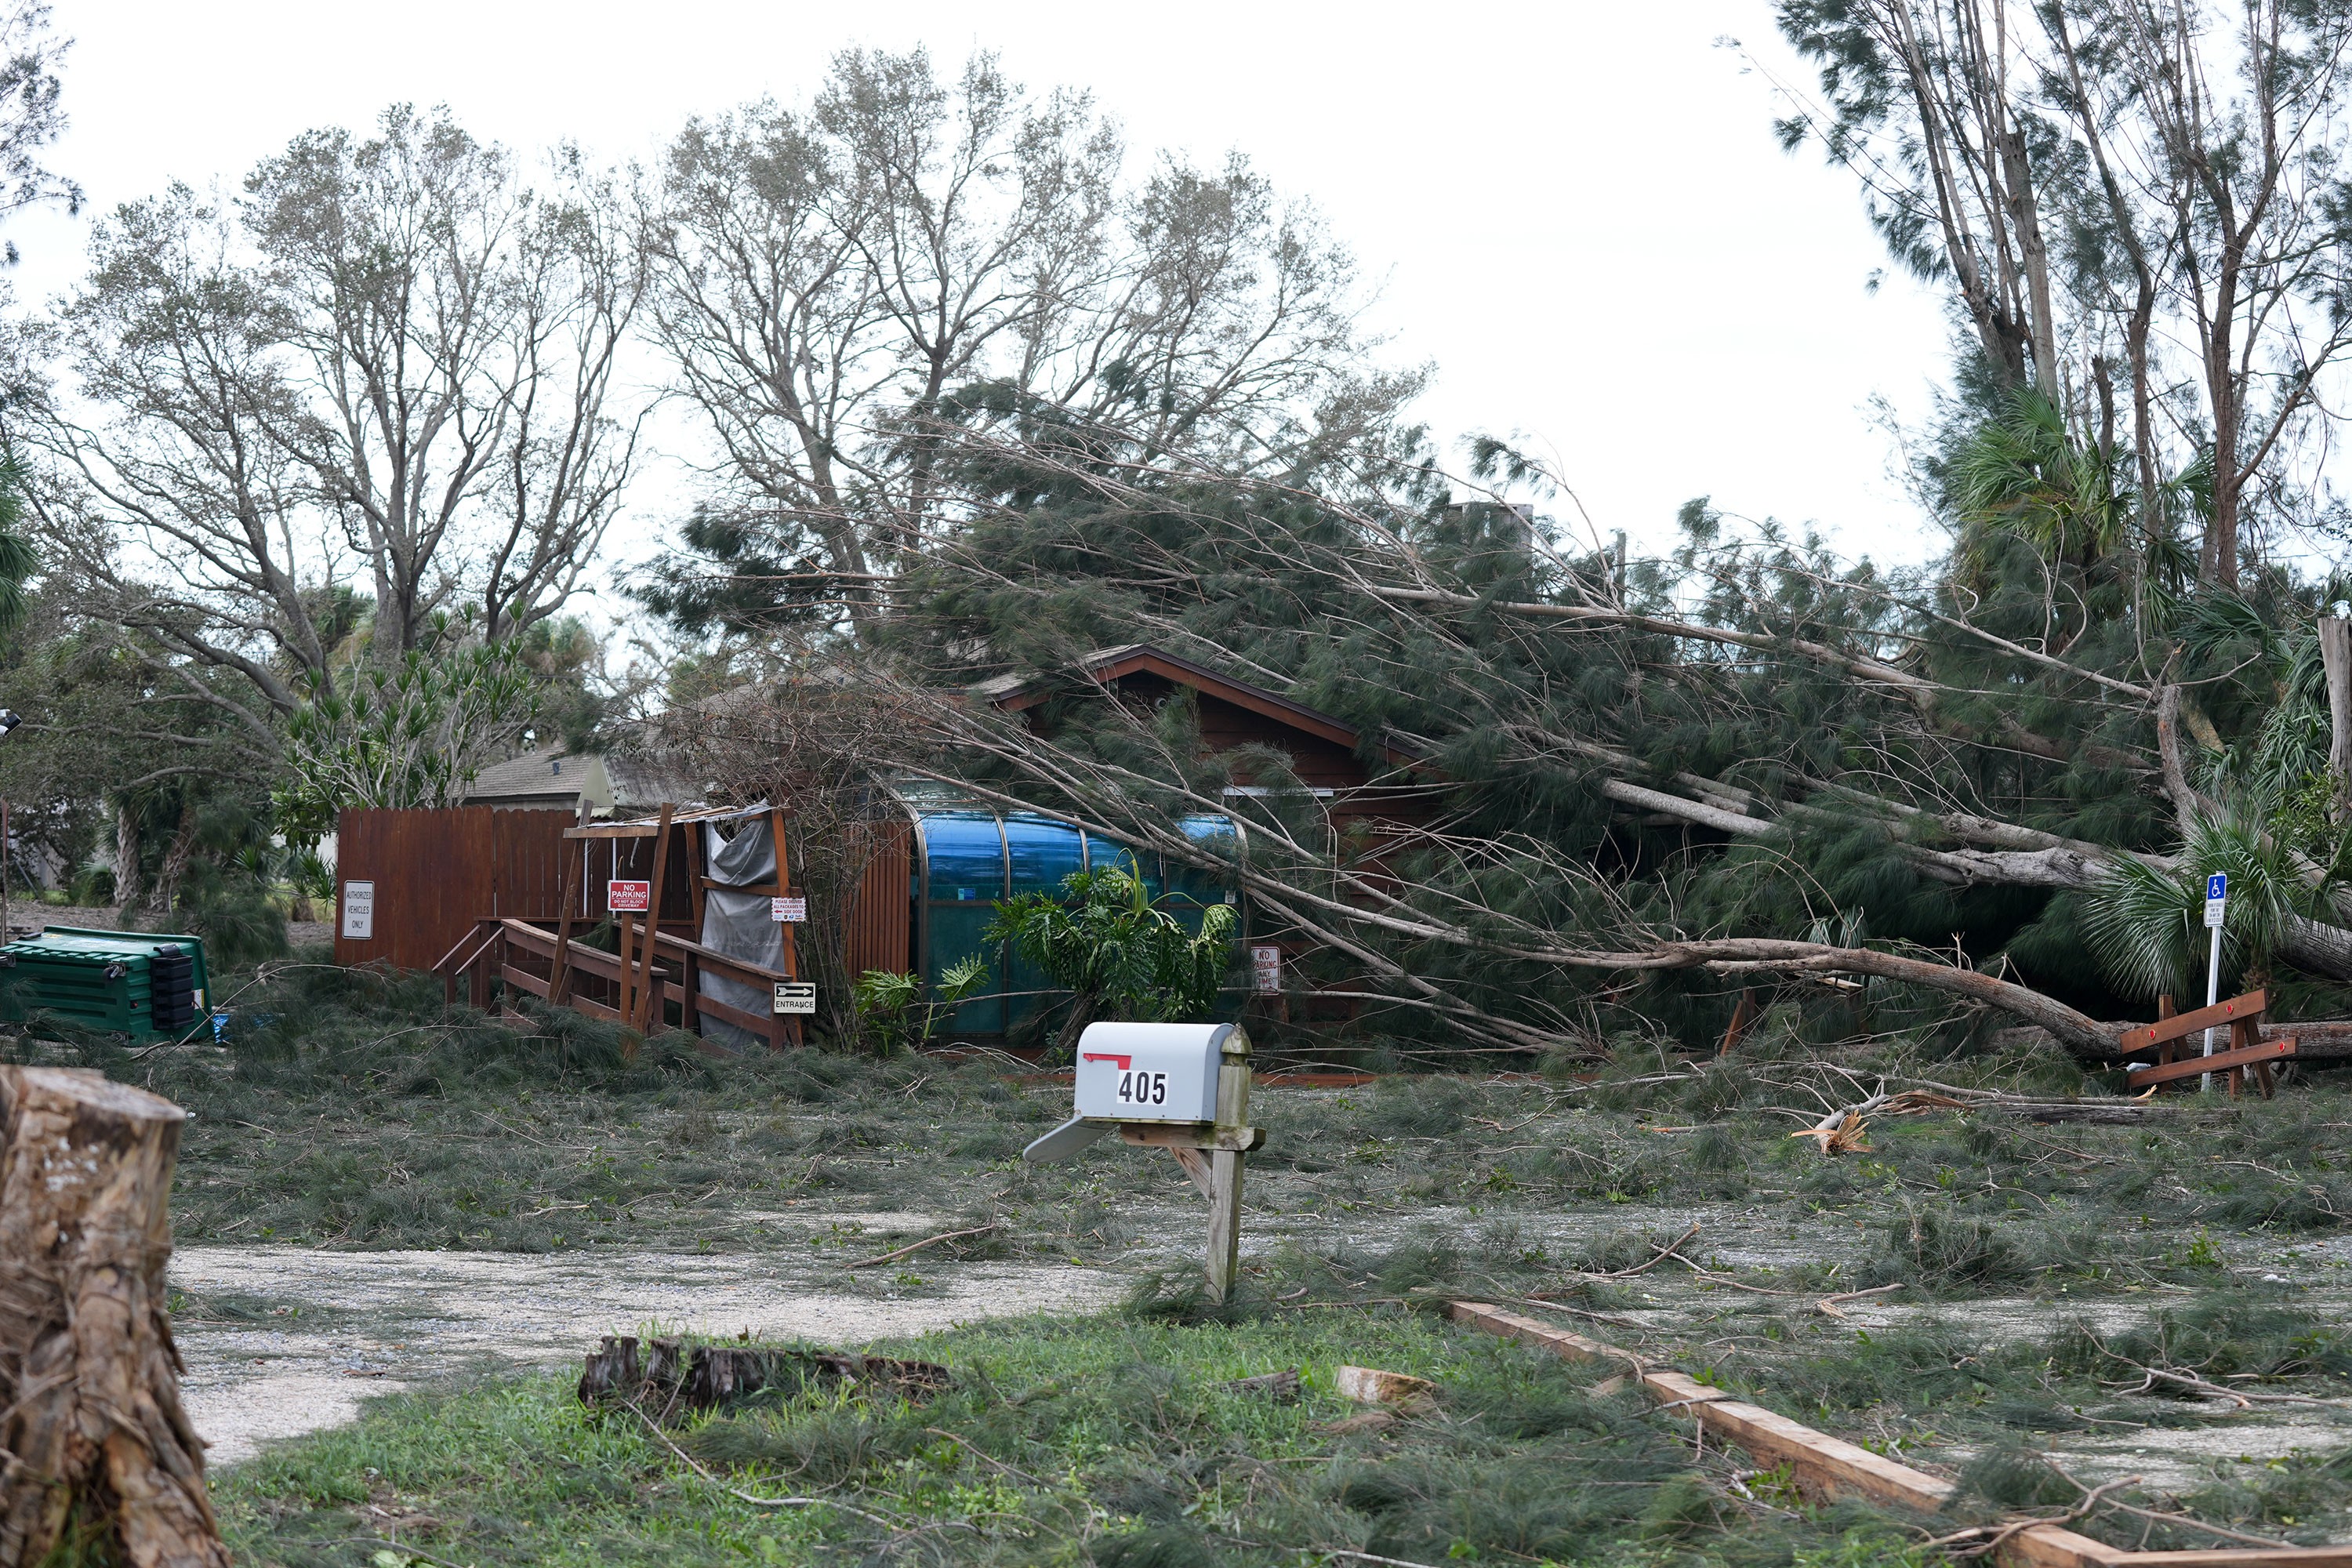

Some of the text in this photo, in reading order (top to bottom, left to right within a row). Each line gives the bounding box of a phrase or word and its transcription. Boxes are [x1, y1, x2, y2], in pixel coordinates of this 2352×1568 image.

[347, 891, 372, 899] AUTHORIZED
[348, 906, 369, 914] VEHICLES
[352, 920, 364, 928] ONLY
[1259, 951, 1270, 960] NO
[1253, 960, 1276, 969] PARKING
[1119, 1072, 1166, 1105] 405
